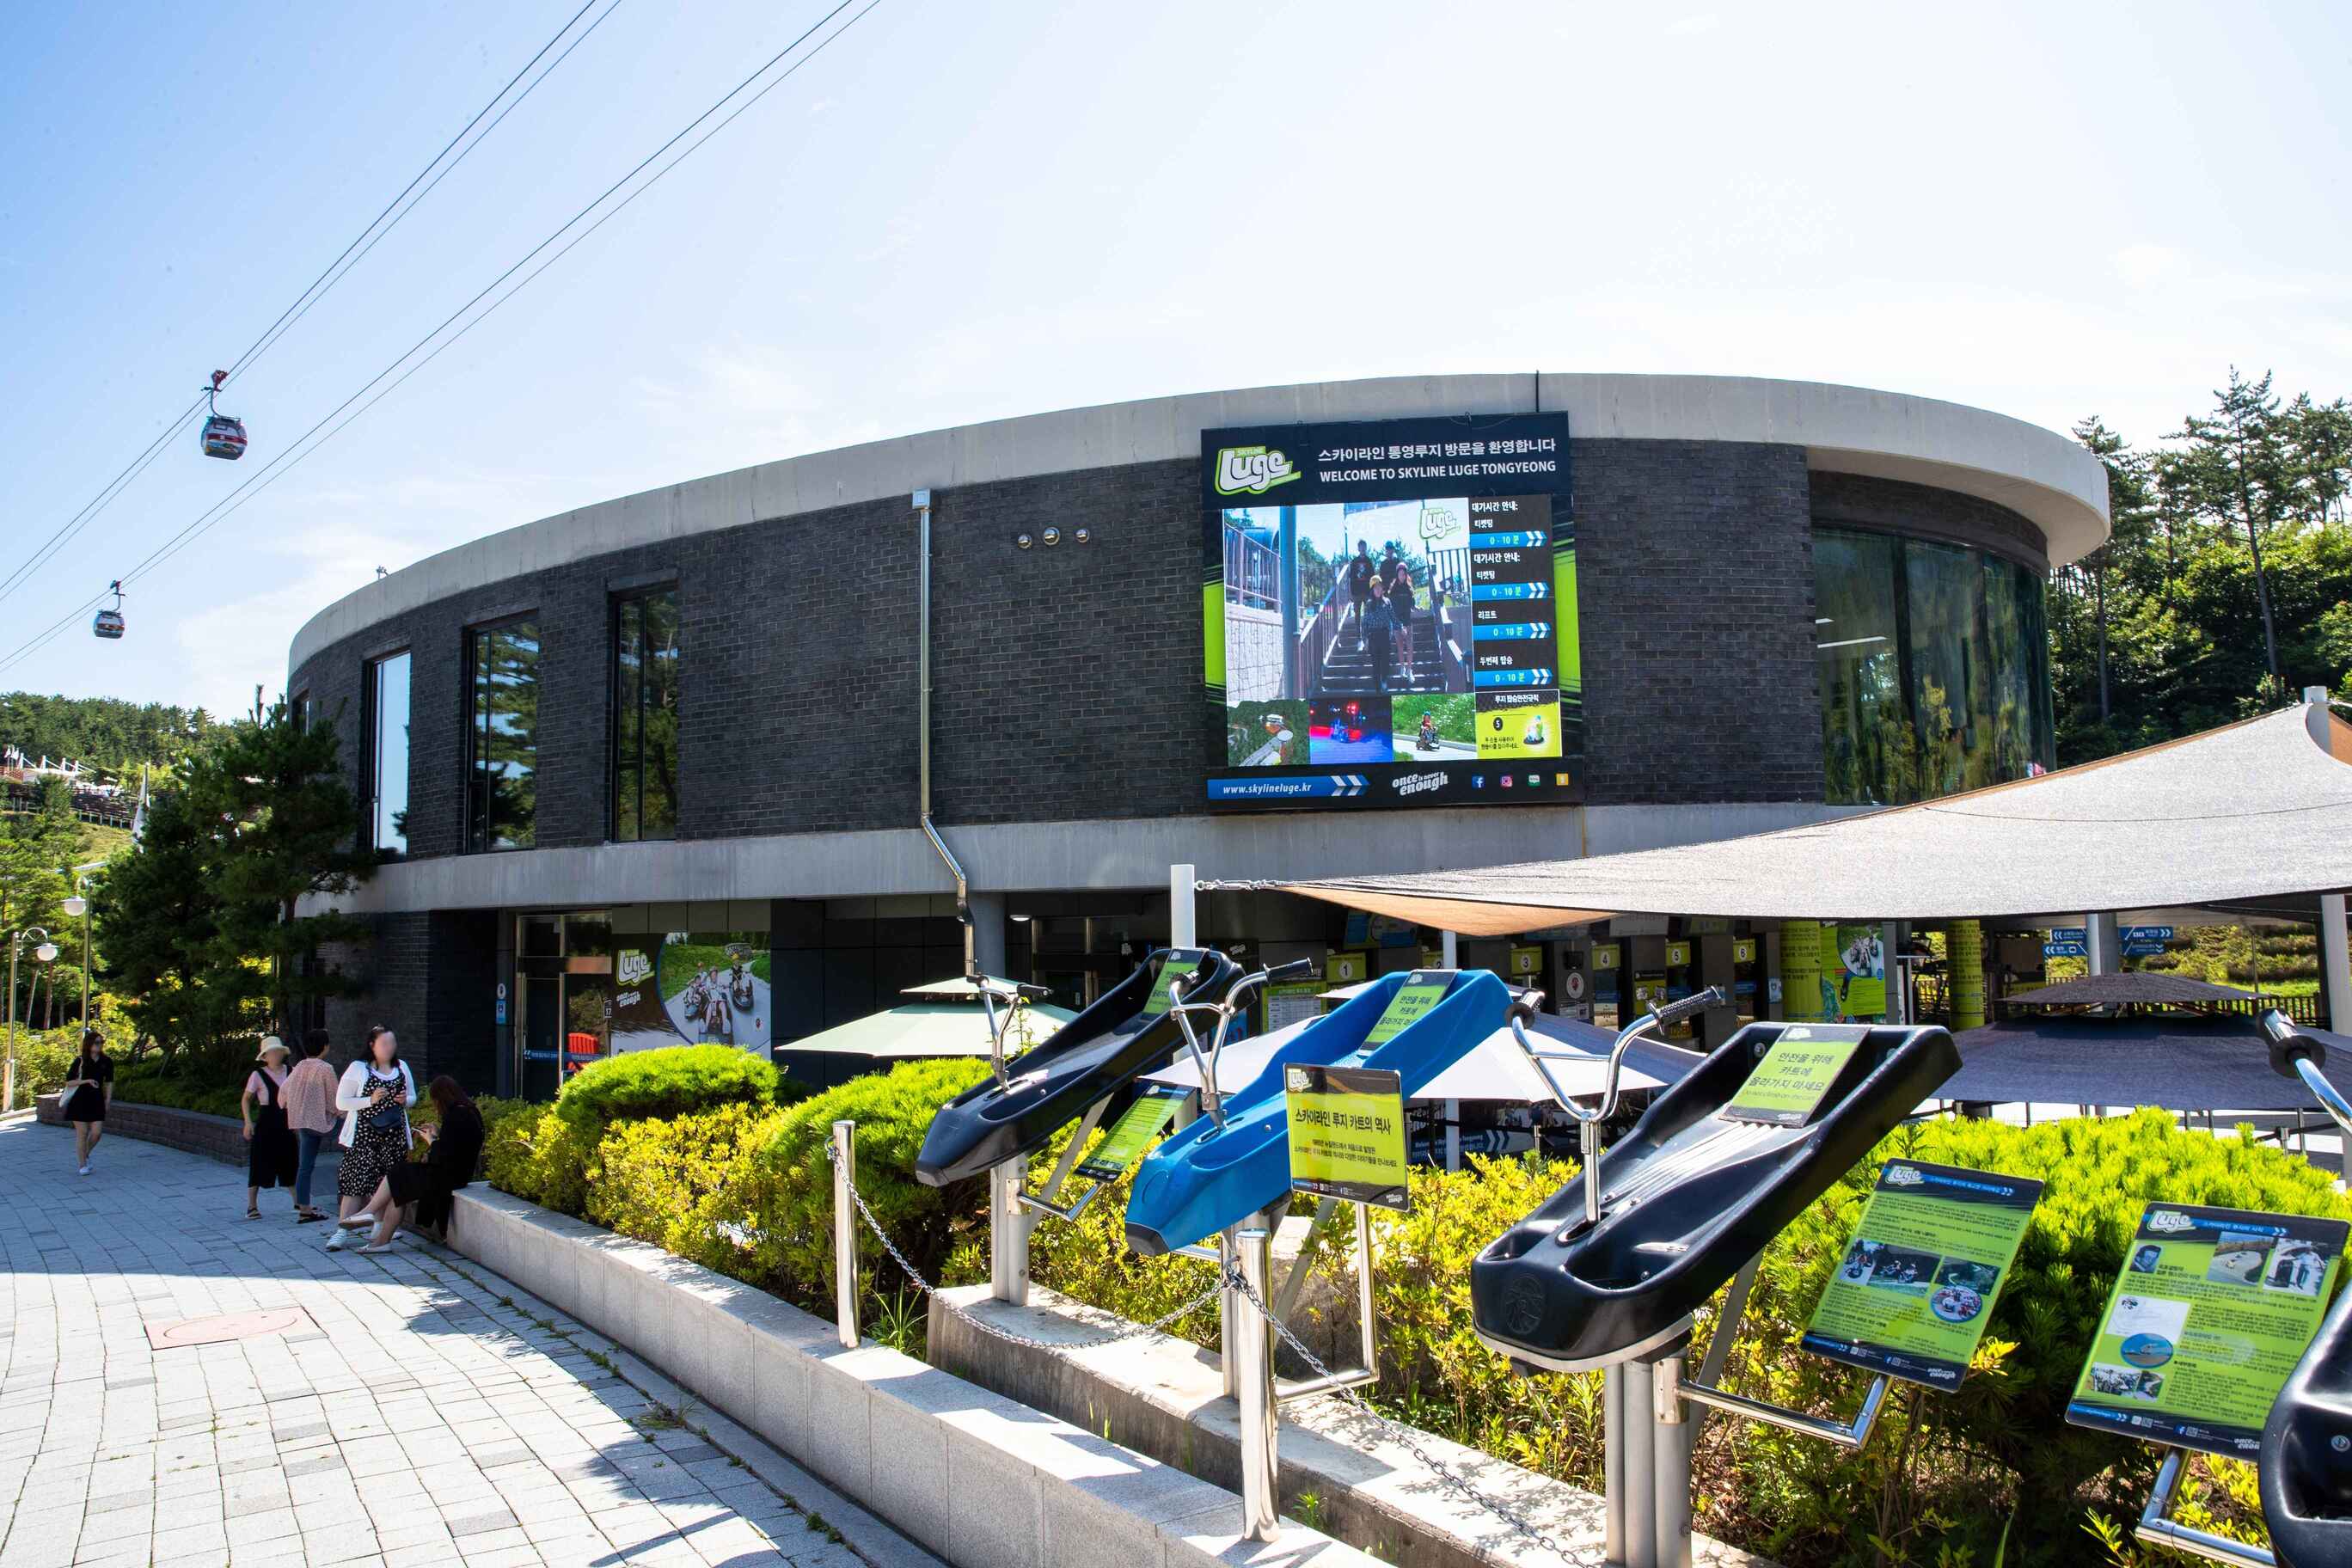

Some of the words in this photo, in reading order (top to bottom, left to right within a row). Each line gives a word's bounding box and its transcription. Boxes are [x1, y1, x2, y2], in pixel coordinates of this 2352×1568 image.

[1318, 446, 1385, 462] 스카이라인
[1387, 444, 1442, 459] 통영루지
[1444, 442, 1485, 456] 방문을
[1488, 438, 1557, 455] 환영합니다
[1320, 469, 1377, 482] WELCOME
[1380, 469, 1395, 480] TO
[1398, 466, 1447, 479] SKYLINE
[1449, 463, 1479, 476] LUGE
[1481, 461, 1557, 475] TONGYEONG
[1471, 501, 1500, 512] 대기시간
[1478, 610, 1498, 620] 리프트
[1392, 773, 1418, 788] once
[1400, 771, 1449, 796] enough
[1223, 782, 1313, 796] www.skylineluge.kr
[1522, 957, 1528, 968] 3
[1344, 965, 1348, 976] 1
[1778, 1052, 1810, 1063] 안전을
[1811, 1055, 1836, 1065] 위해
[1779, 1066, 1812, 1075] 카트에
[1749, 1076, 1792, 1088] 올라가지
[1792, 1081, 1825, 1092] 마세요
[1295, 1108, 1331, 1127] 스카이라인
[1332, 1112, 1348, 1130] 루지
[1350, 1114, 1373, 1132] 카트의
[1375, 1118, 1391, 1135] 역사
